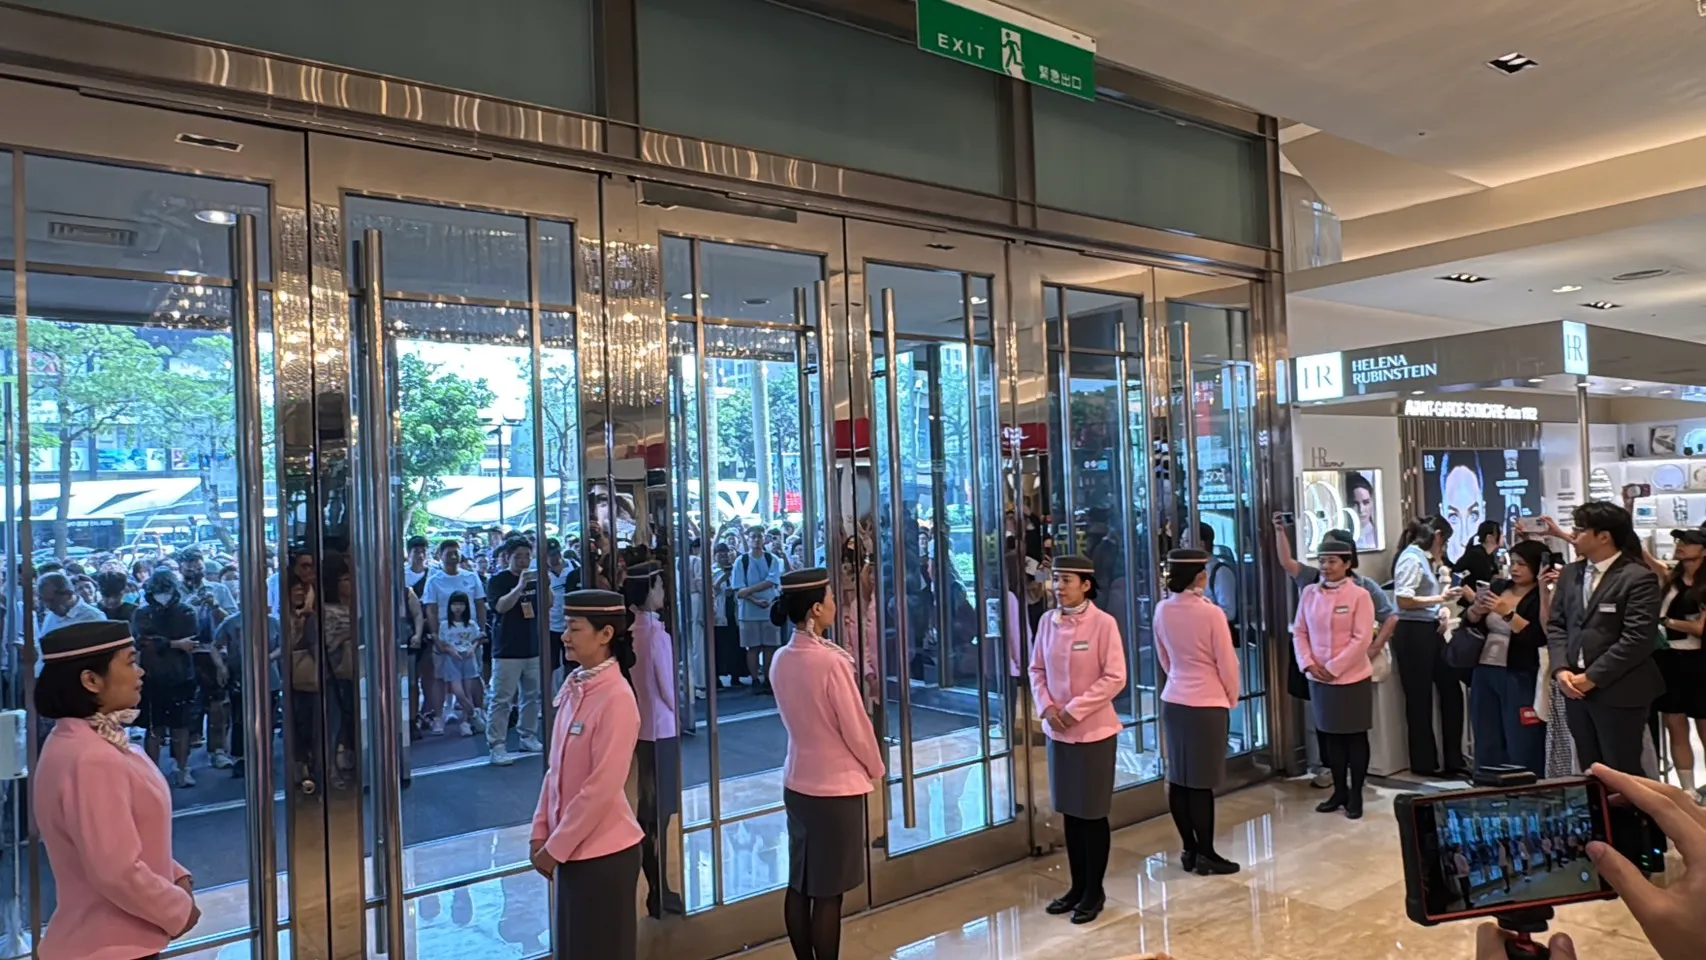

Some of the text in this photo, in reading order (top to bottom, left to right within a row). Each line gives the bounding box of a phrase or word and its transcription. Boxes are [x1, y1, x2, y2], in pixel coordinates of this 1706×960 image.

[938, 33, 985, 59] EXIT
[1039, 65, 1082, 90] 緊急出口
[1567, 334, 1584, 362] HR
[1352, 354, 1407, 371] HELENA
[1353, 363, 1437, 384] RUBINSTEIN
